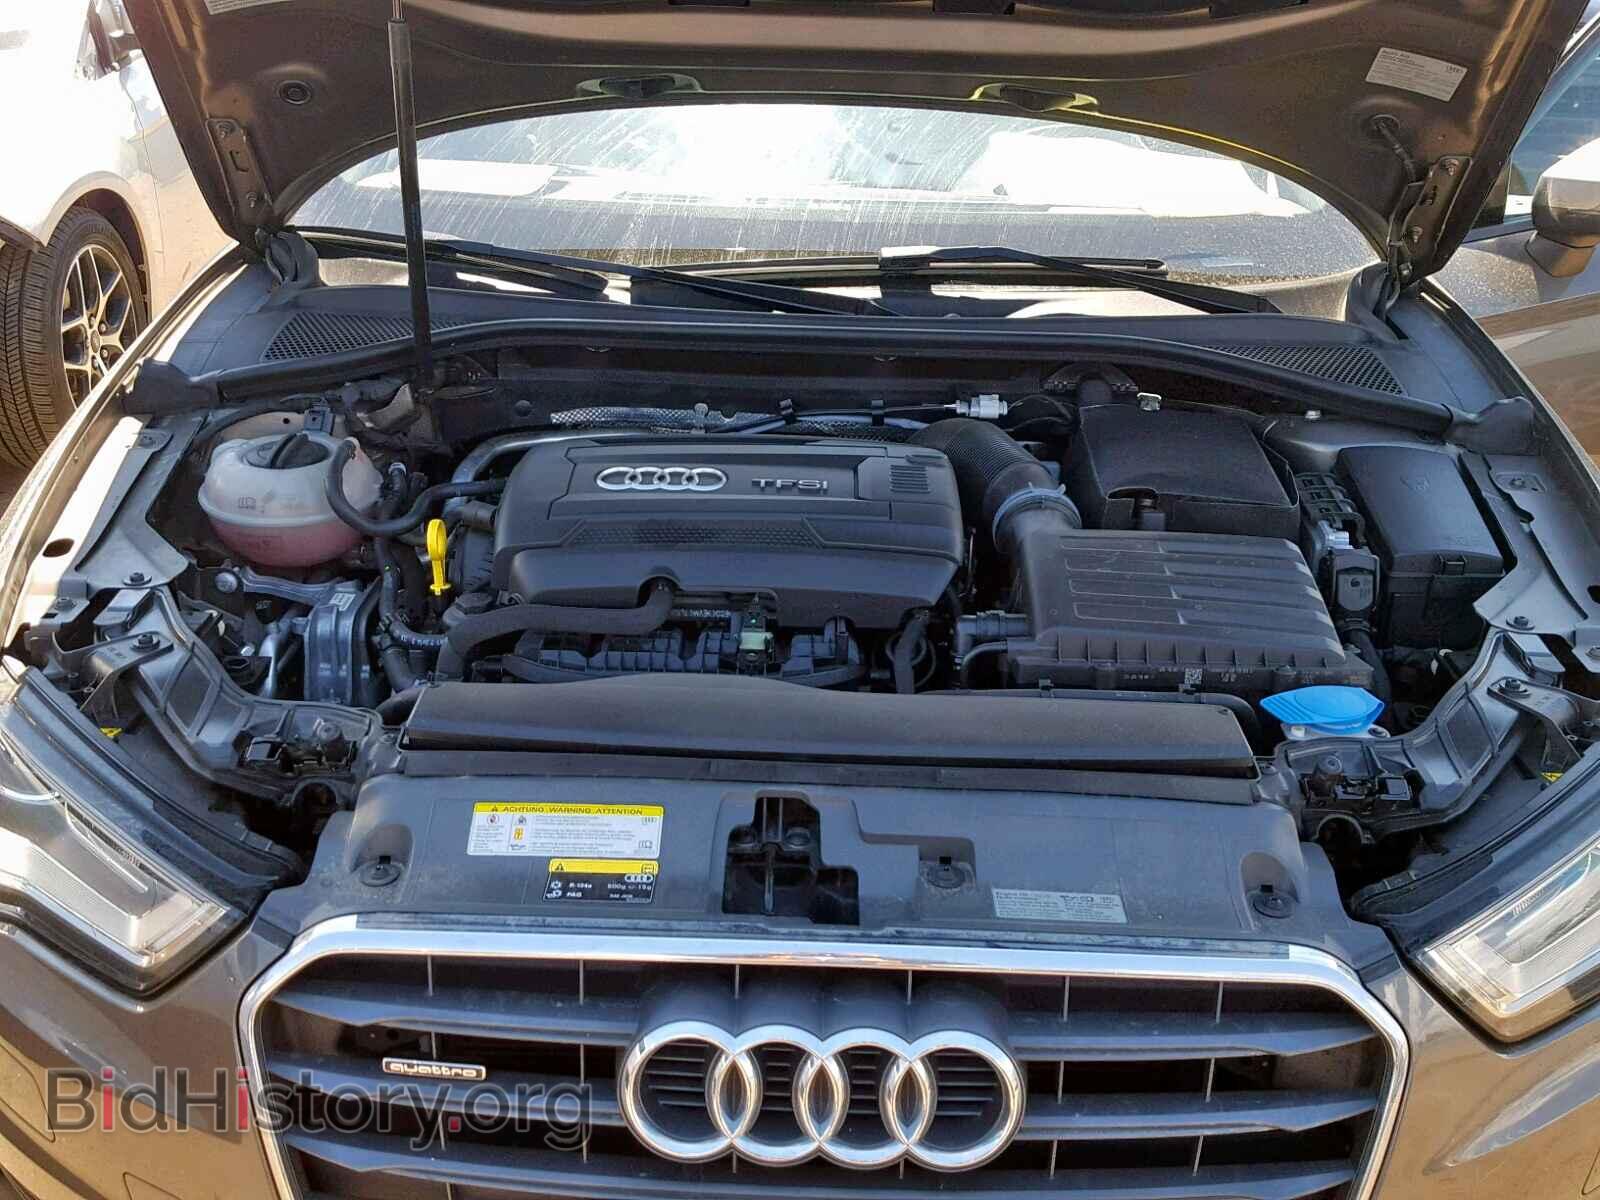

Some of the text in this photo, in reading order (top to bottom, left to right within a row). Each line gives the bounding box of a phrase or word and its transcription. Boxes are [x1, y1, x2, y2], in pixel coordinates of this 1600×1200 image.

[751, 478, 829, 490] TFSI
[502, 805, 643, 815] ACHTUNG WARNING ATTENTION
[389, 1062, 477, 1077] quattro
